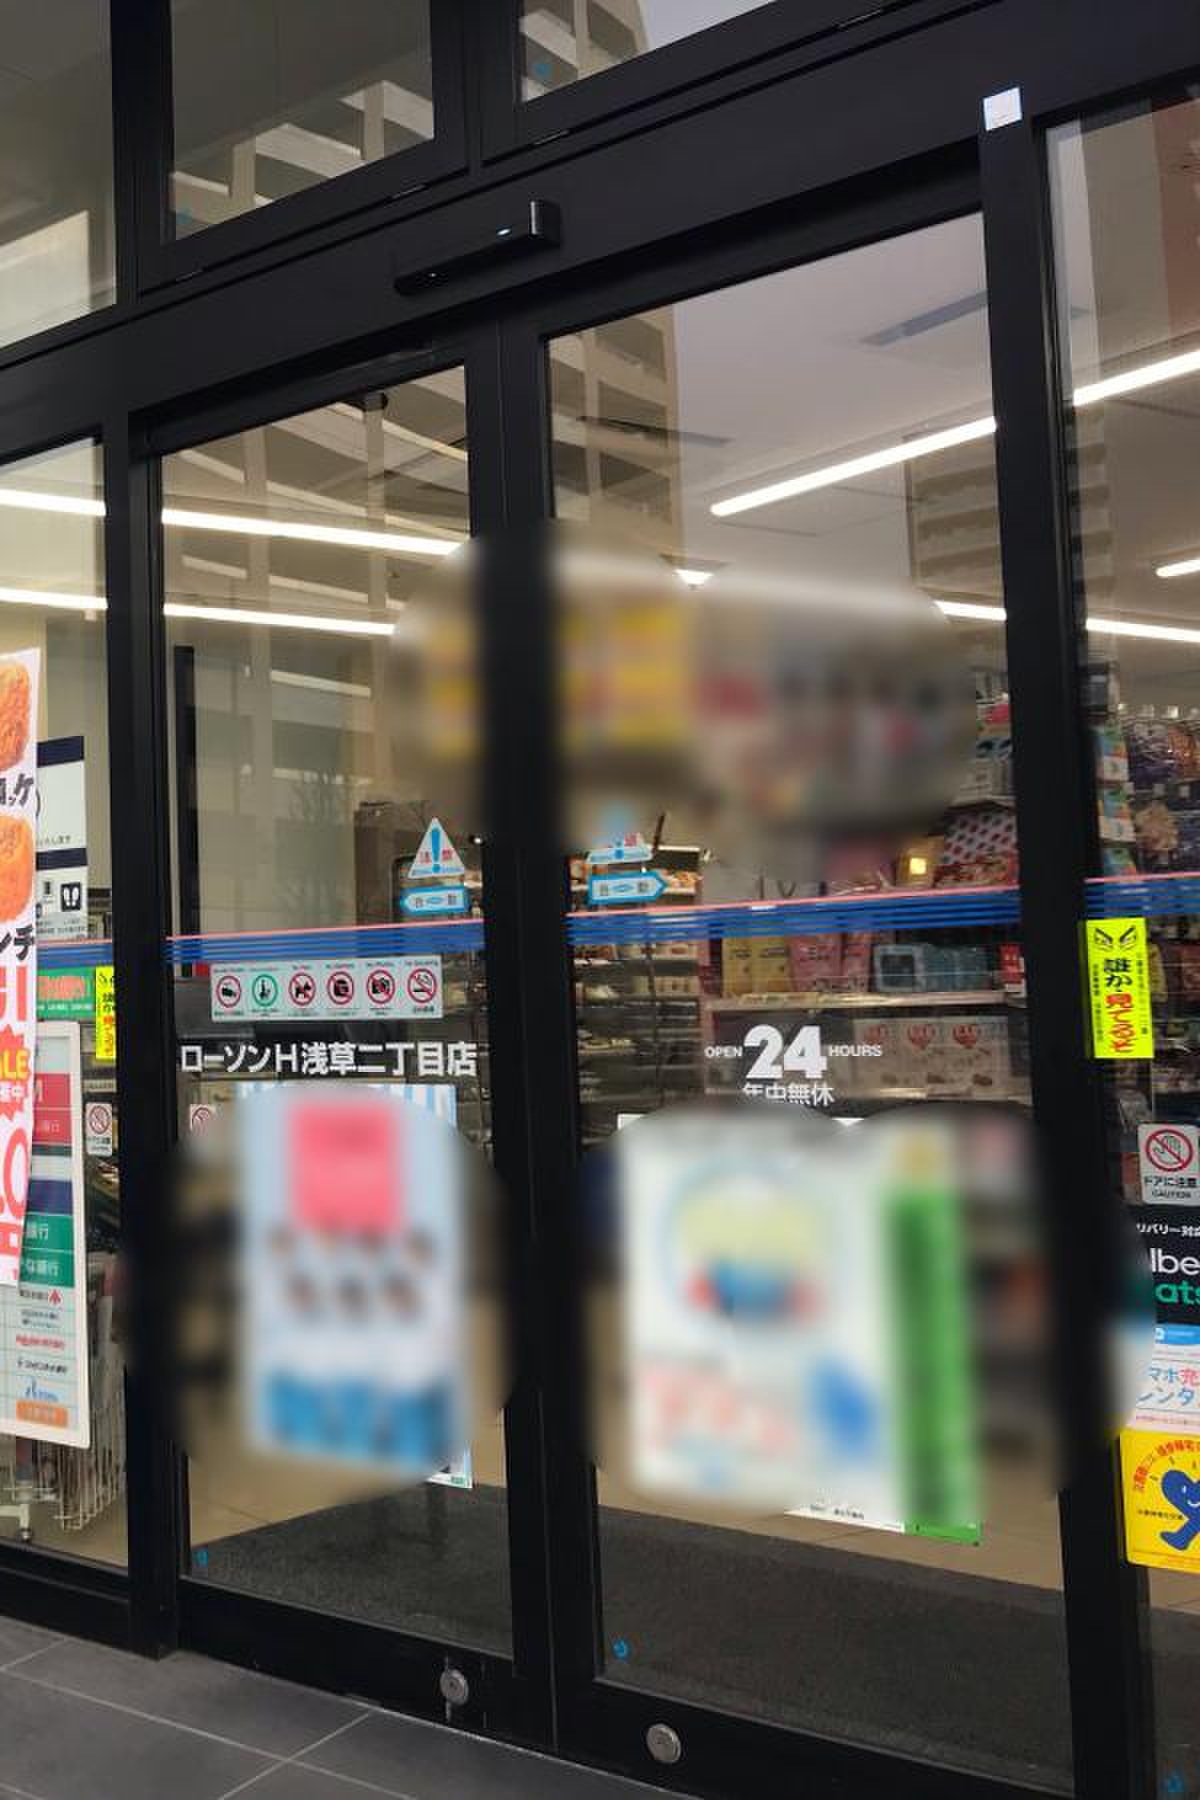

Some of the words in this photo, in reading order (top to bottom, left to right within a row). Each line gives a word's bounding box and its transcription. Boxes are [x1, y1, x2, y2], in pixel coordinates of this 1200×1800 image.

[181, 1042, 478, 1077] ローソンH浅草二丁目店
[704, 1046, 743, 1058] OPEN
[743, 1024, 828, 1079] 24
[828, 1045, 883, 1057] HOURS
[742, 1082, 835, 1107] 年中無休
